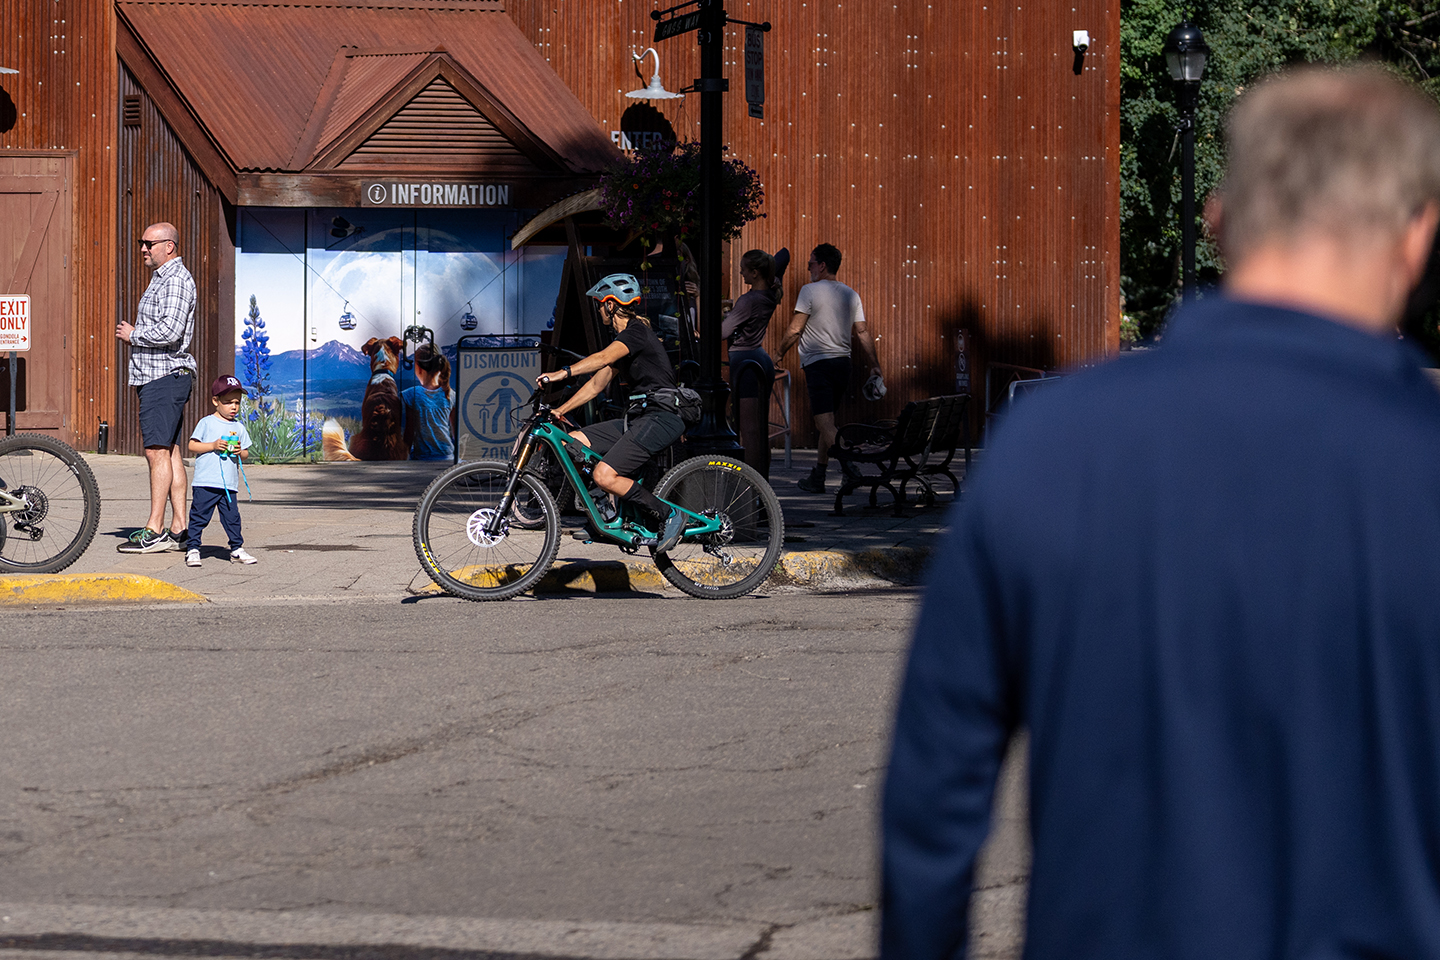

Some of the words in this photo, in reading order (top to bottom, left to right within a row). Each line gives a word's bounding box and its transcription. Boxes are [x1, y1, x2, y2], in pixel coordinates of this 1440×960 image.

[684, 13, 701, 30] WAY
[747, 33, 761, 48] BUS
[746, 50, 763, 65] STOP
[611, 130, 663, 151] ENTER
[391, 184, 509, 206] INFORMATION
[0, 301, 27, 316] EXIT
[0, 316, 27, 330] ONLY
[463, 353, 538, 370] DISMOUNT
[481, 446, 512, 460] ZON
[708, 460, 742, 472] MAXXIS
